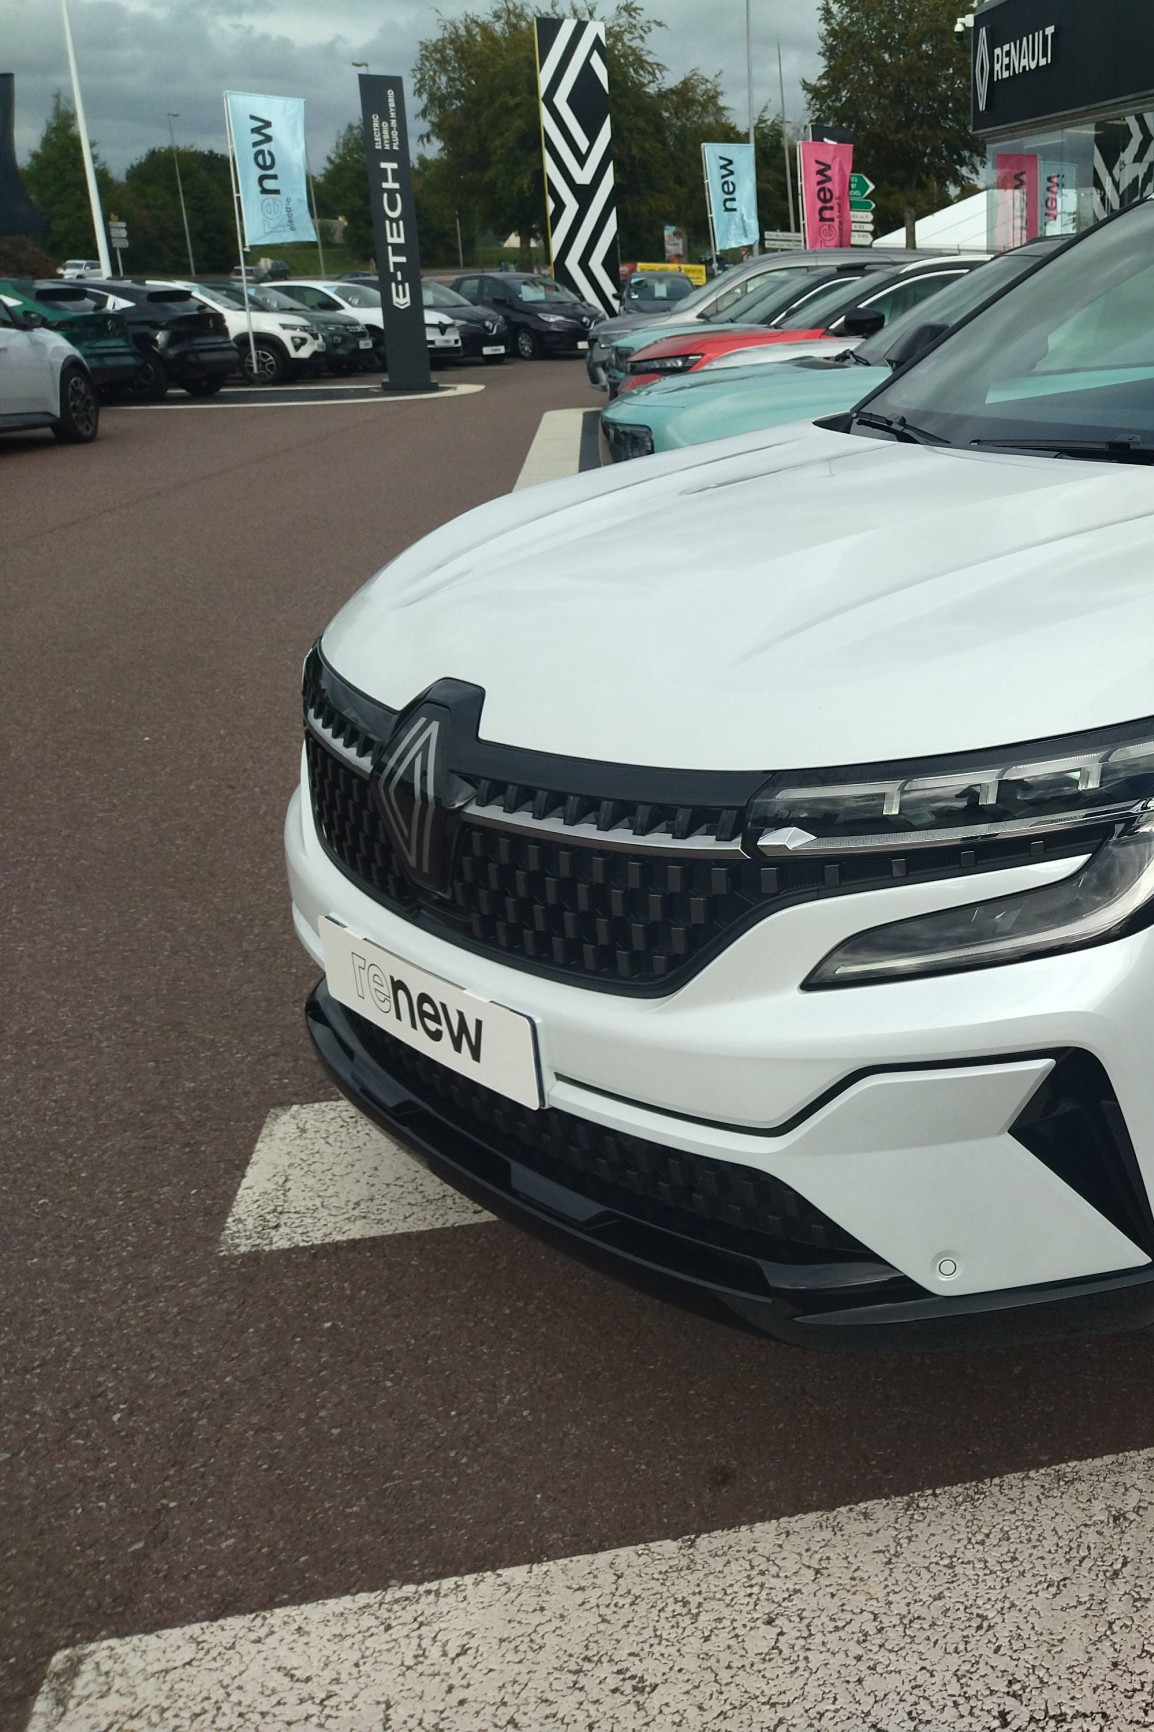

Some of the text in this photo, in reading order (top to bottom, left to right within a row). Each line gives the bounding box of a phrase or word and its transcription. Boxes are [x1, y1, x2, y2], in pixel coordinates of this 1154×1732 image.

[994, 25, 1055, 82] RENAULT
[372, 113, 382, 150] ELECTRIC
[381, 121, 391, 150] HYBRID
[387, 89, 400, 150] PLUG-IN HYBRID
[249, 114, 286, 234] renew
[286, 197, 296, 232] electric
[380, 162, 411, 309] E-TECH
[351, 951, 483, 1064] renew
